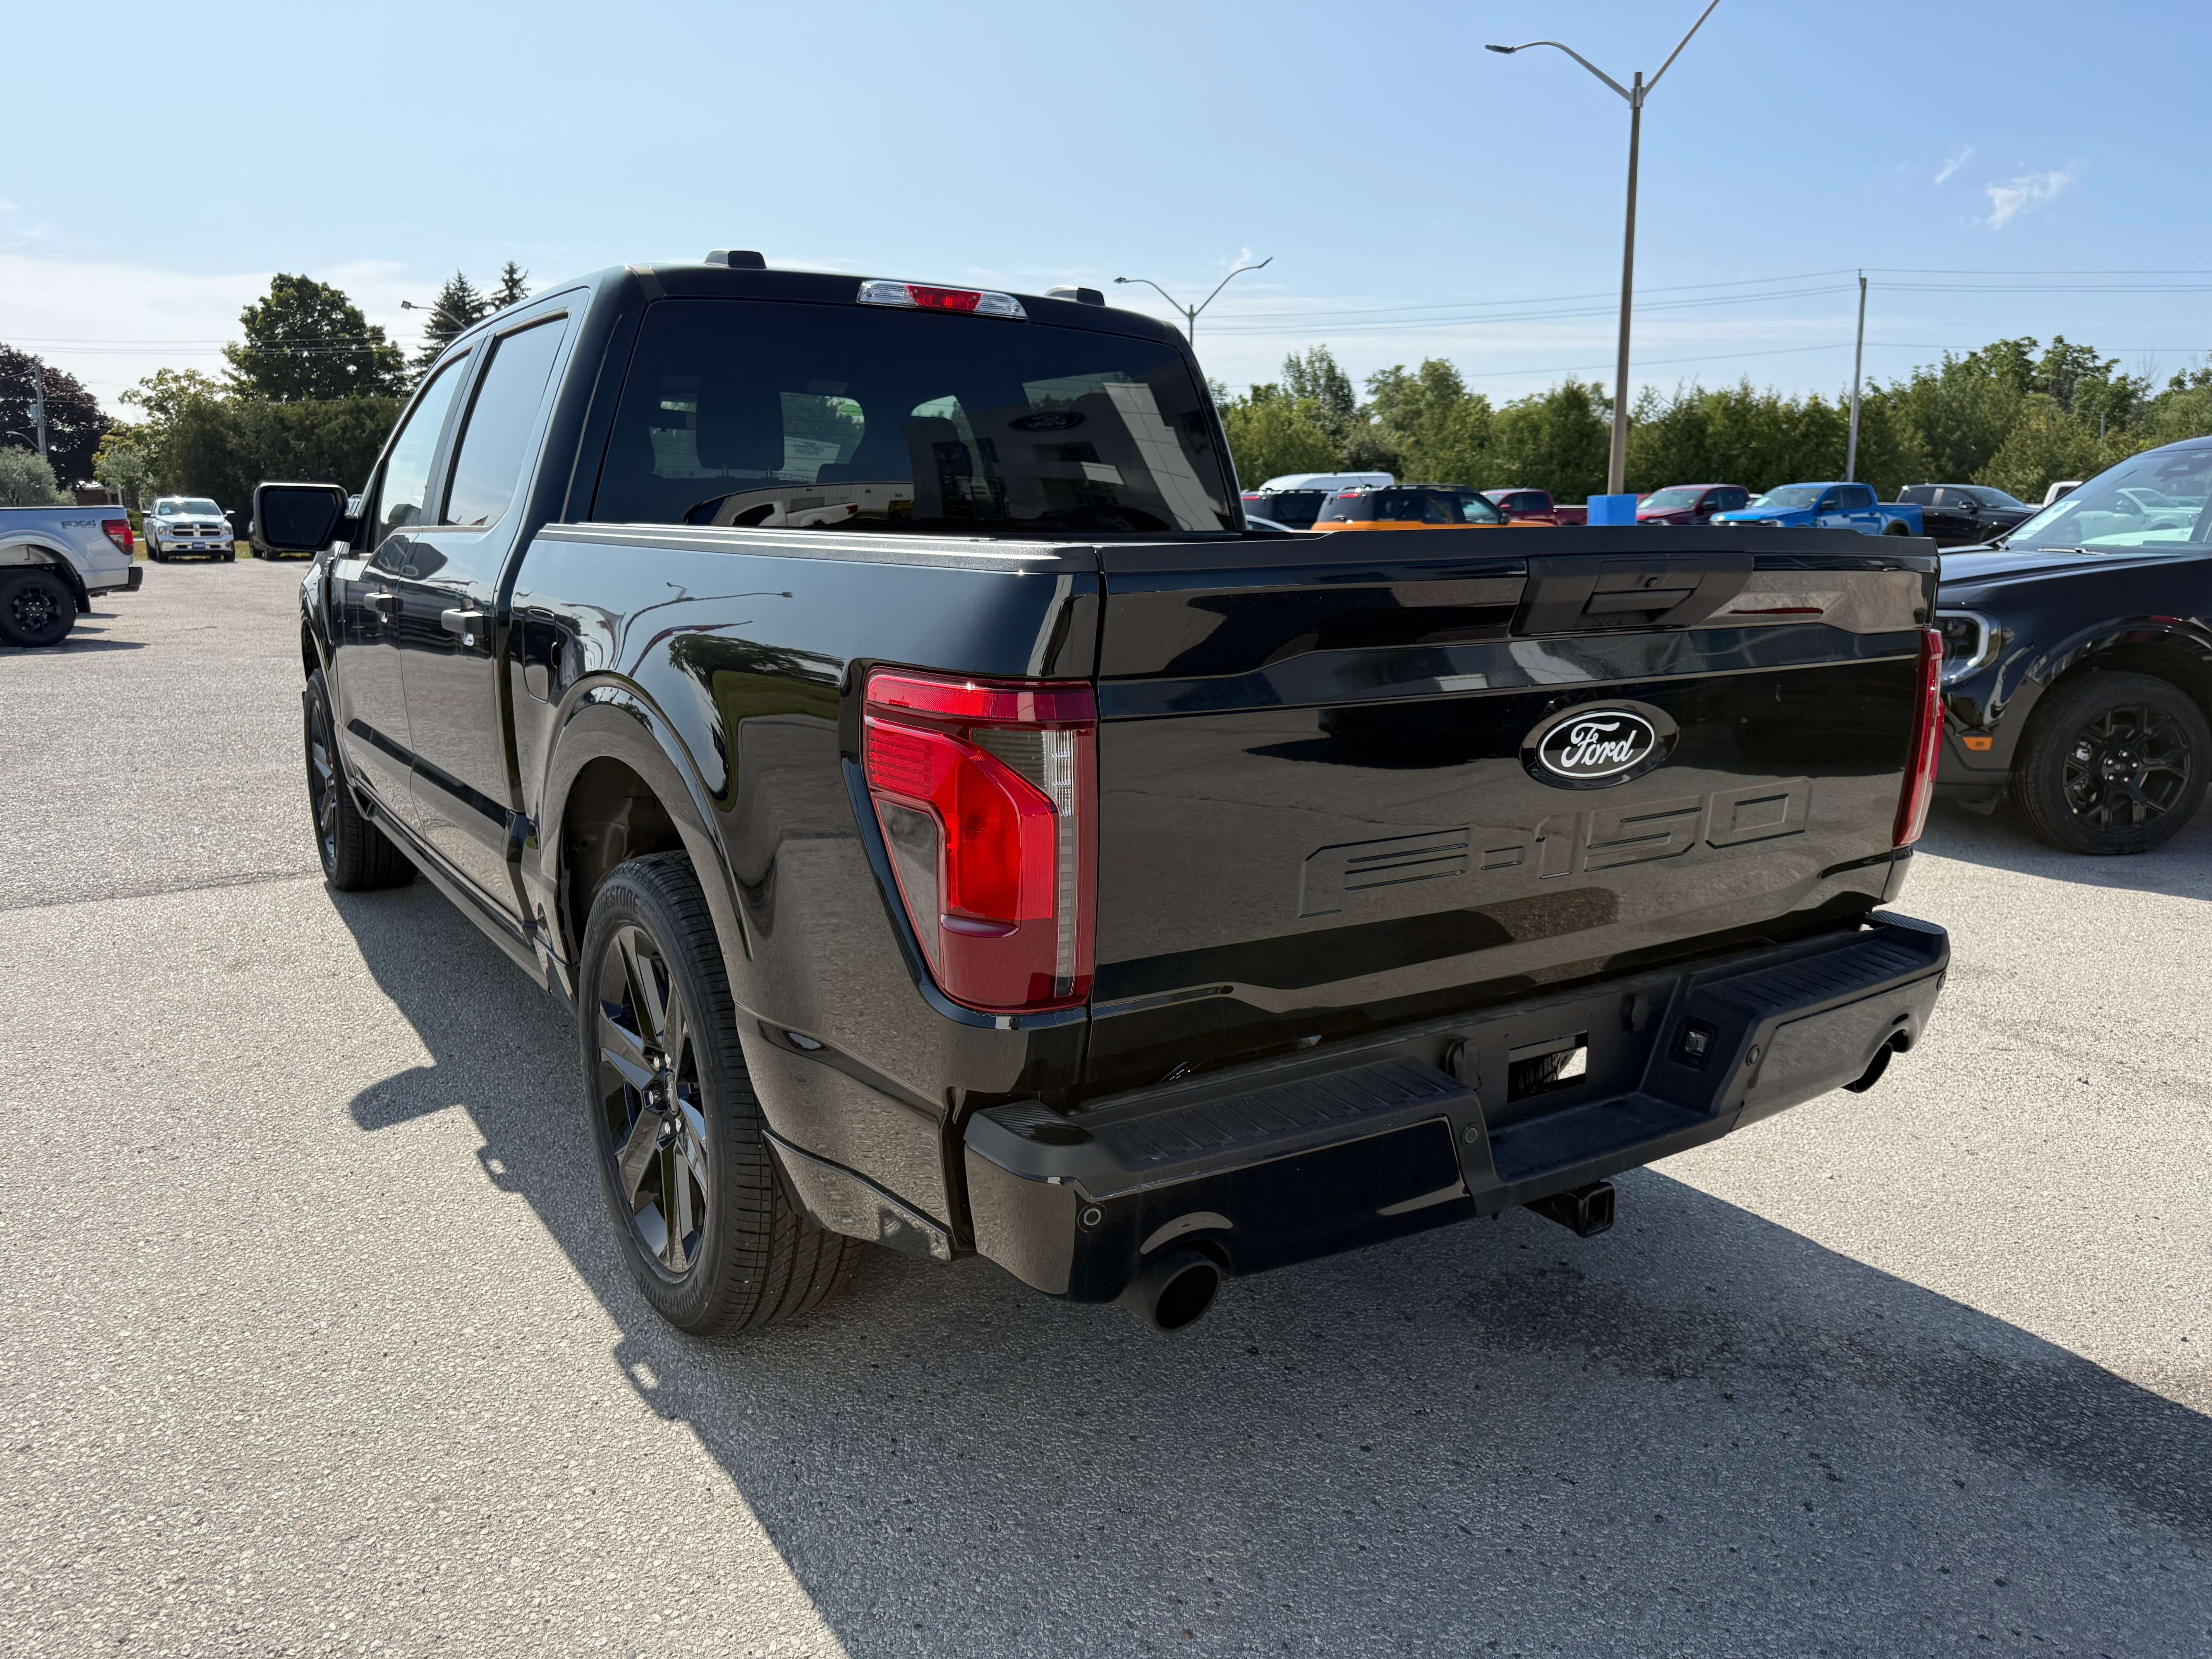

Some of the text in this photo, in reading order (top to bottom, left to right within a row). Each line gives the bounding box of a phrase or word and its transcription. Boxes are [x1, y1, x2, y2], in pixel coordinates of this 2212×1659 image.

[61, 520, 96, 529] FX4
[1561, 722, 1637, 768] Ford
[1298, 776, 1813, 919] F-150
[587, 885, 640, 946] BRIDGESTONE
